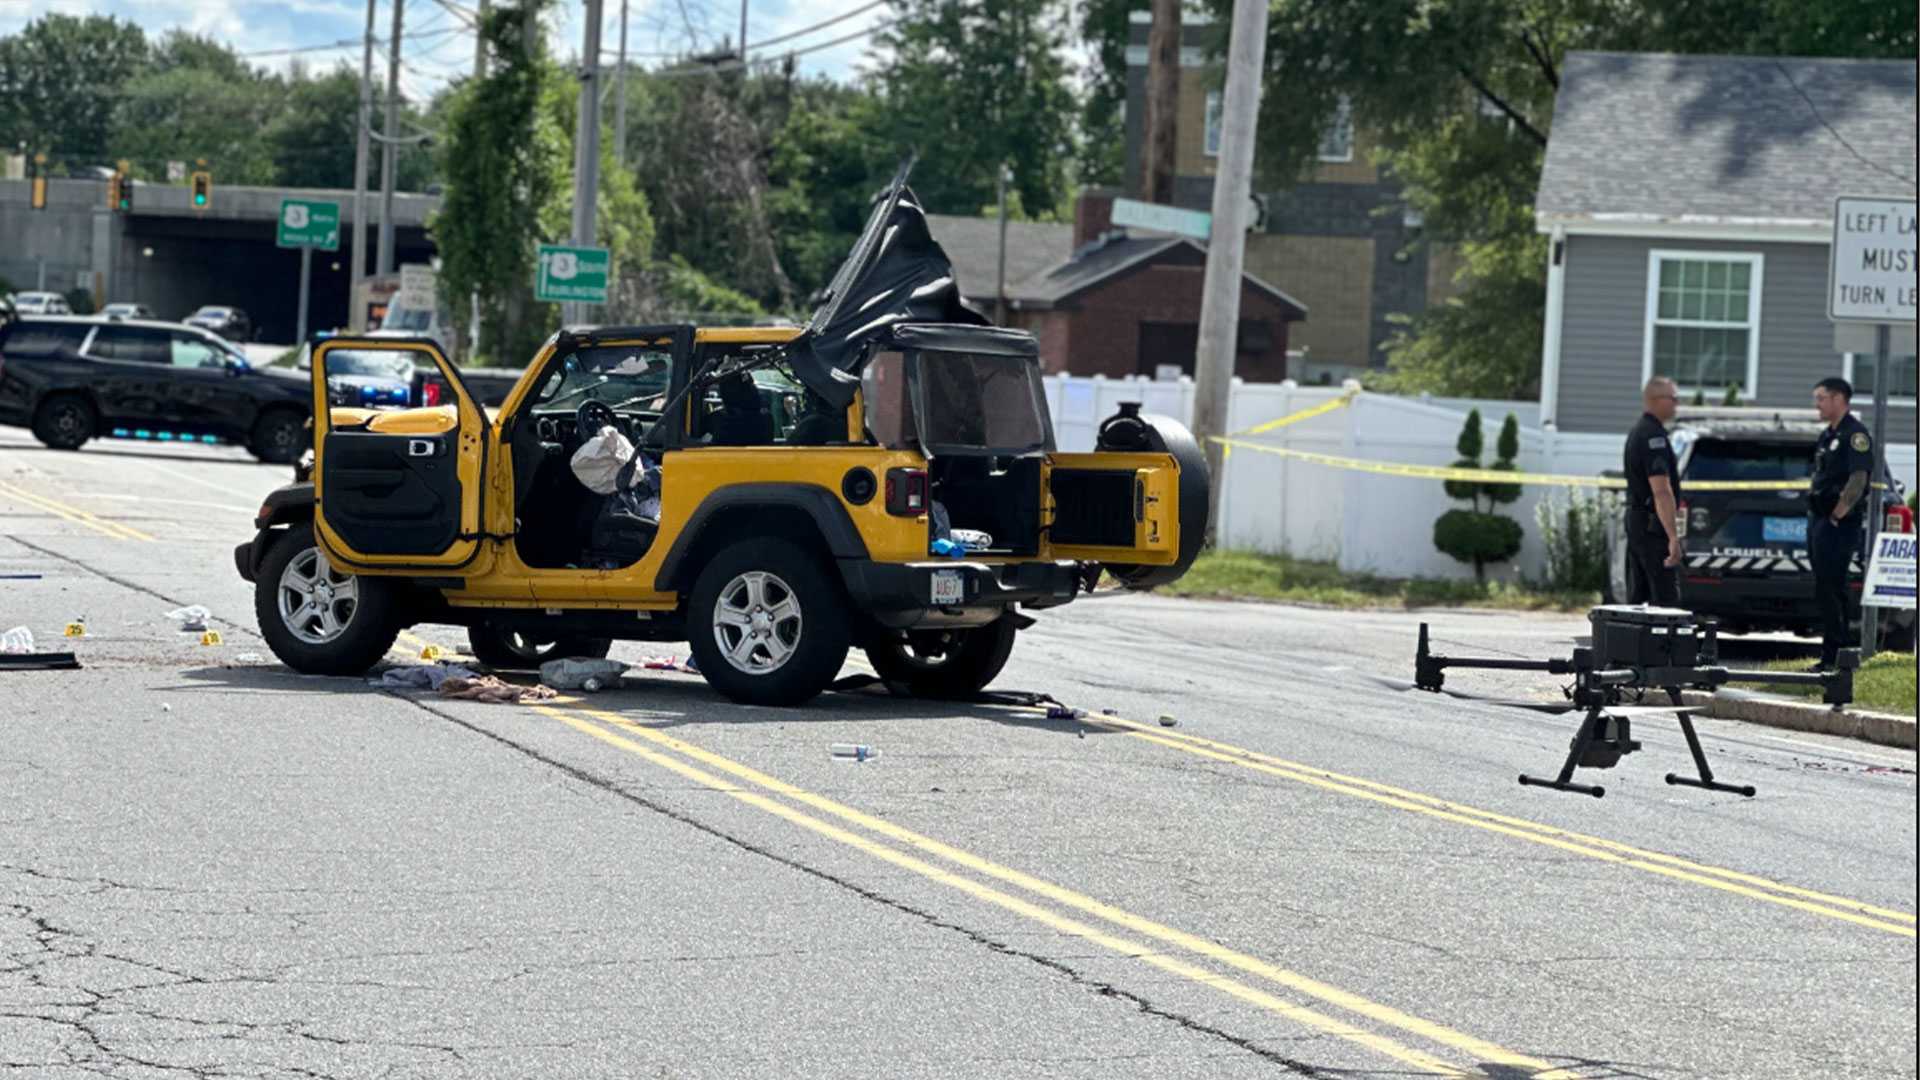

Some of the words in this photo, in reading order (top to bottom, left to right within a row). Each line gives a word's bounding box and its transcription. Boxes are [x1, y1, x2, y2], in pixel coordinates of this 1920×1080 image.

[1845, 212, 1888, 233] LEFT
[559, 256, 570, 273] 3
[1840, 284, 1886, 305] TURN
[1712, 546, 1788, 560] LOWELL
[1878, 538, 1916, 560] TARA
